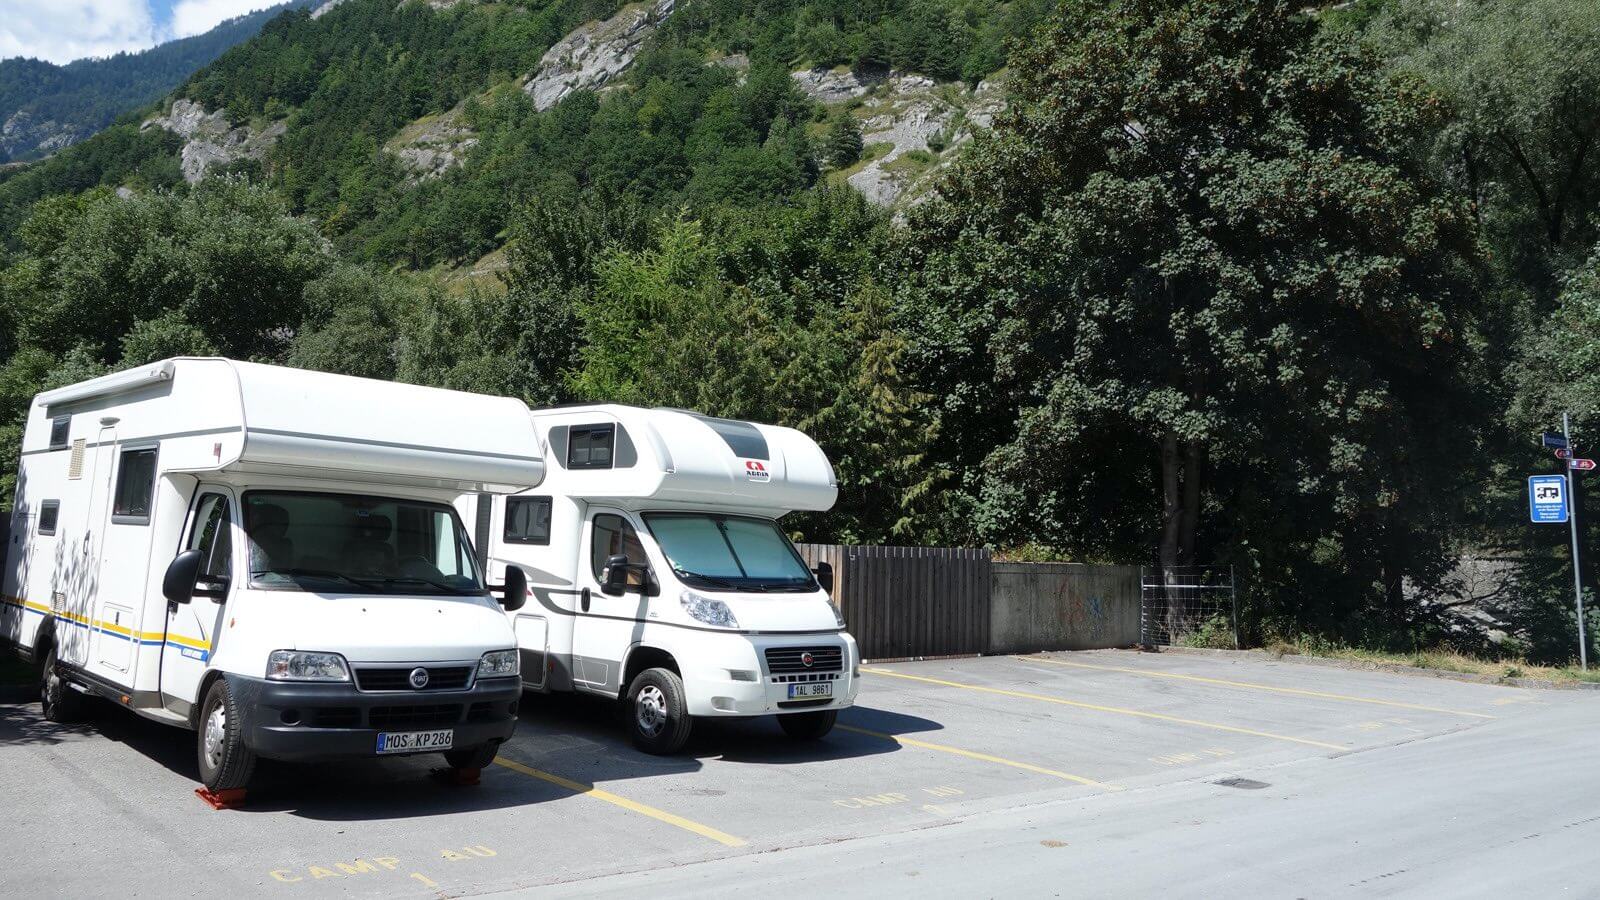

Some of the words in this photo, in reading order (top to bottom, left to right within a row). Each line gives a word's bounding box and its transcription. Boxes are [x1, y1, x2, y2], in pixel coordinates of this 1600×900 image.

[796, 686, 807, 695] 1AL
[386, 734, 408, 748] MOS
[416, 734, 430, 747] KP
[432, 732, 451, 745] 286
[270, 857, 400, 882] CAMP
[440, 845, 498, 861] AU
